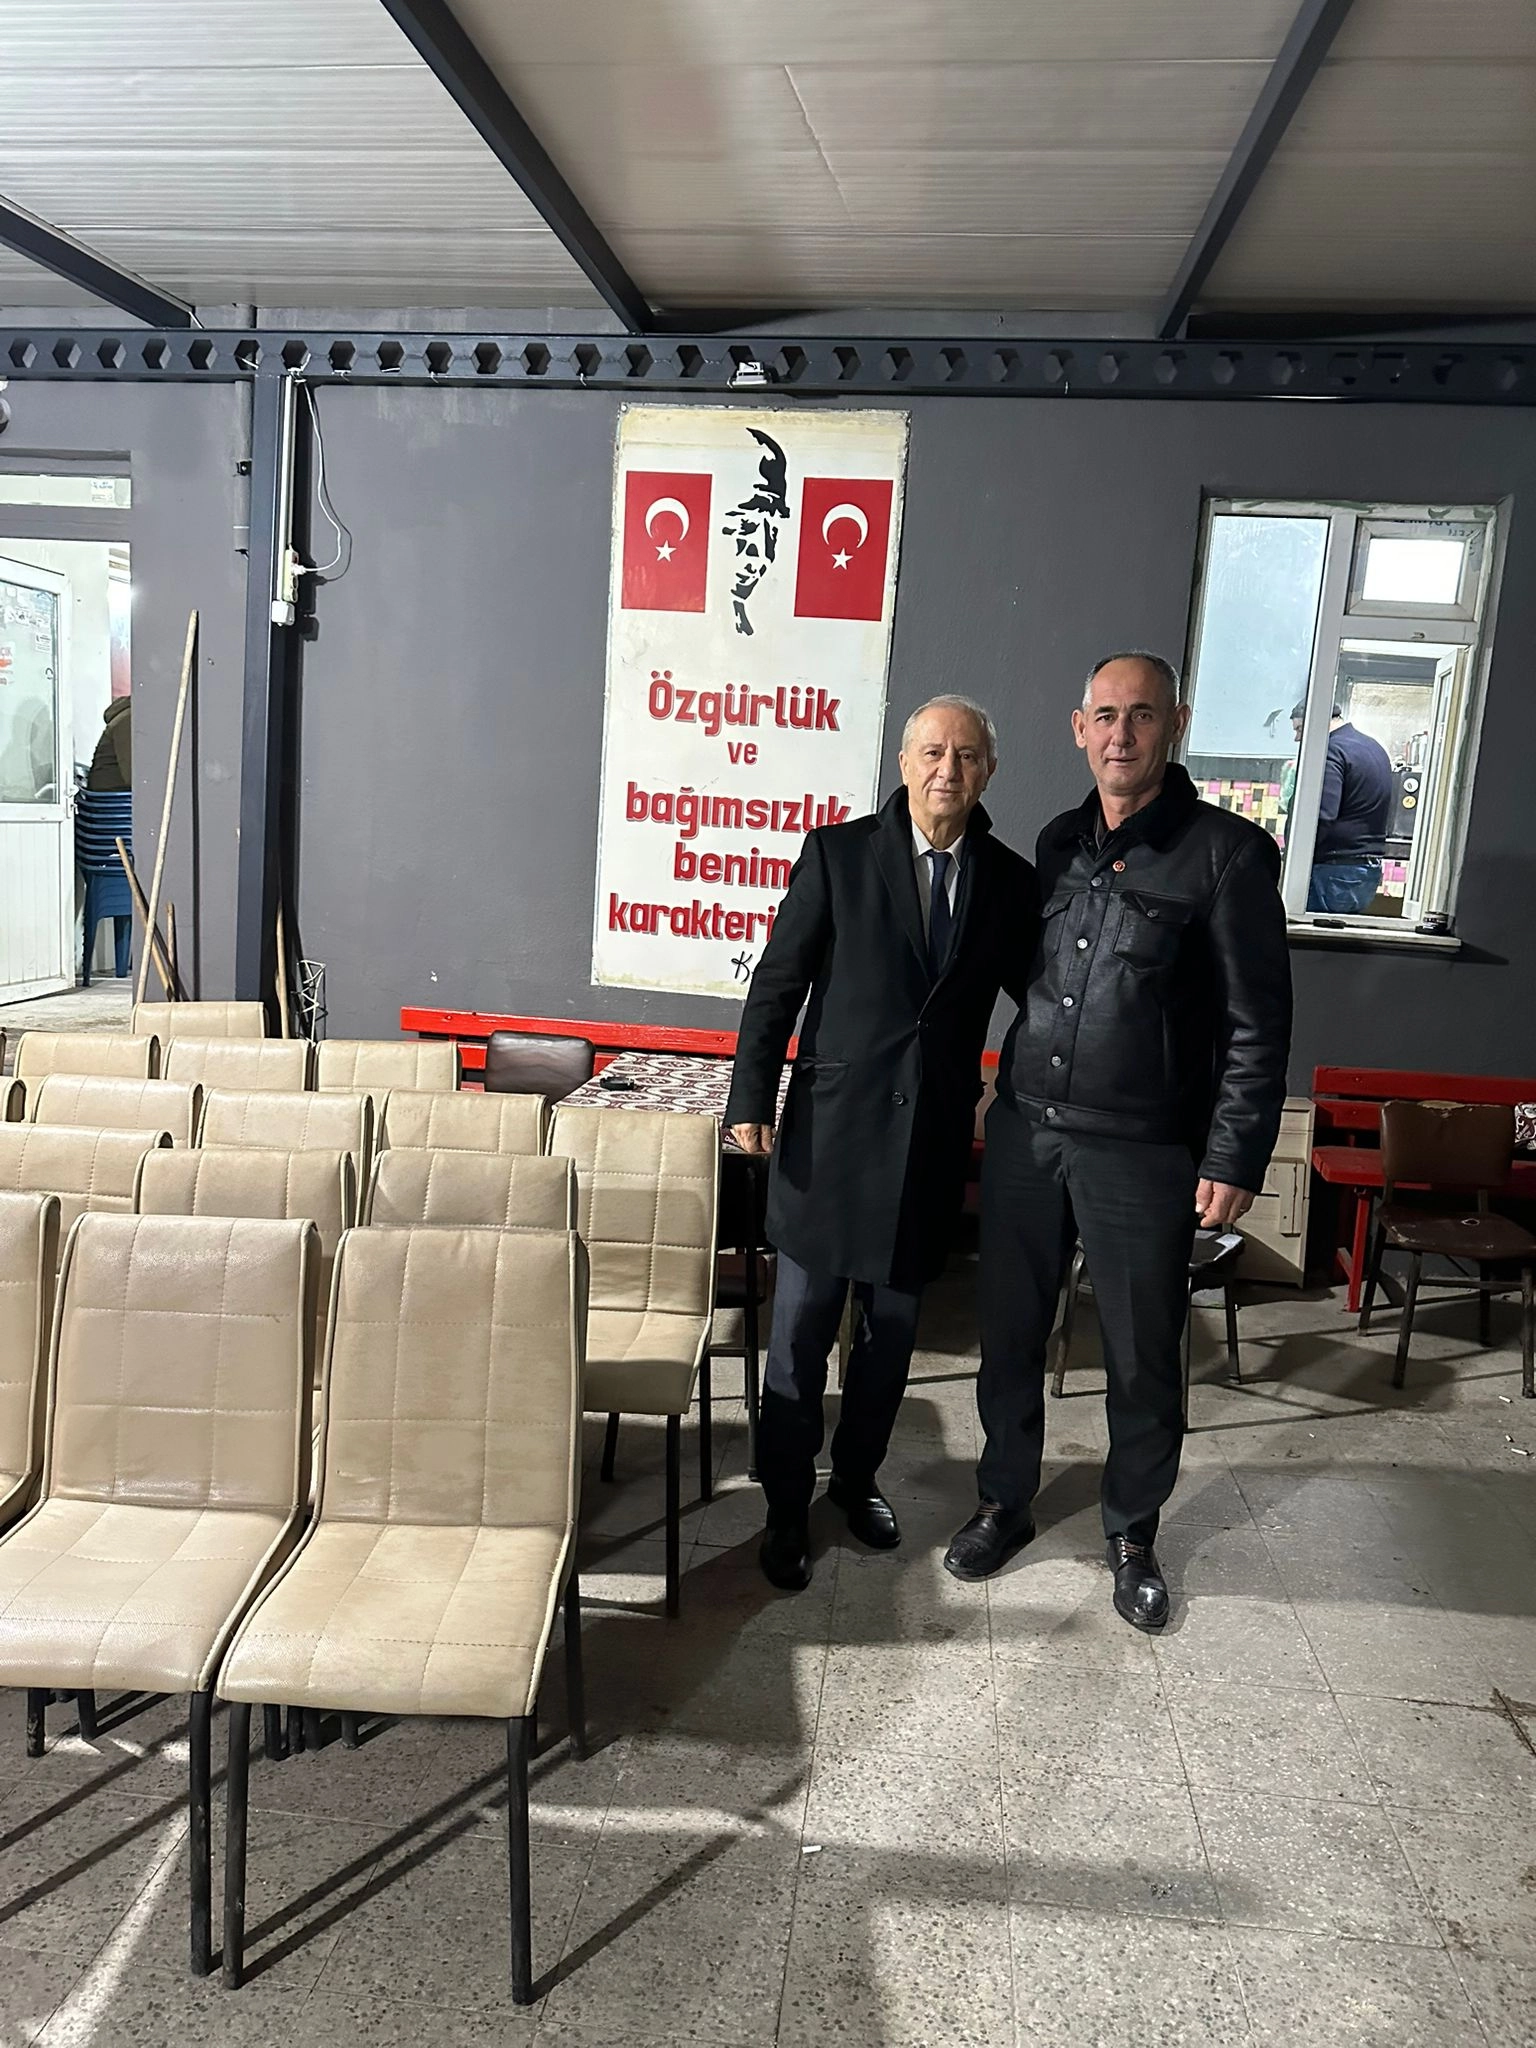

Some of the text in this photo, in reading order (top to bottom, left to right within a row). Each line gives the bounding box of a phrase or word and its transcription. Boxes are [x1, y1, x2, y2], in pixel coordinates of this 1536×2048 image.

[648, 669, 841, 736] Özgürlük
[727, 741, 758, 765] ve
[625, 781, 851, 839] bağımsızlık
[673, 842, 792, 890] benim
